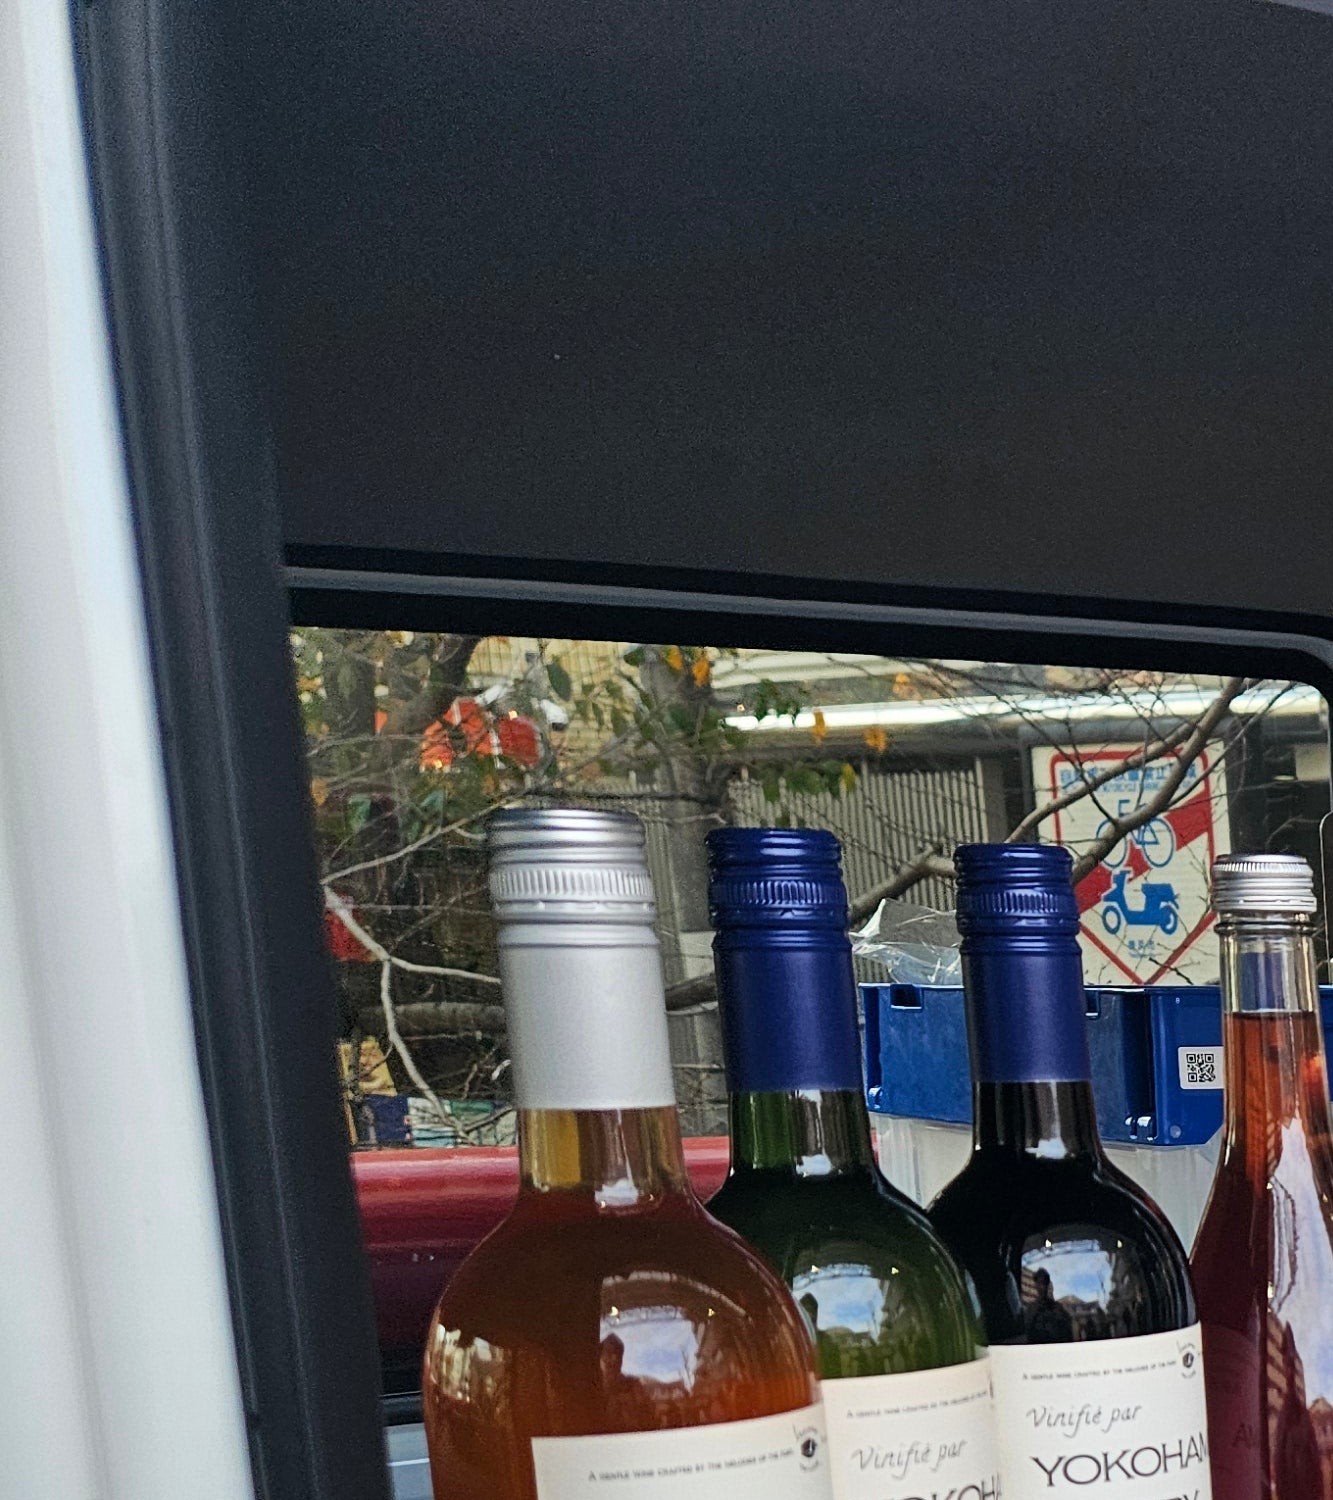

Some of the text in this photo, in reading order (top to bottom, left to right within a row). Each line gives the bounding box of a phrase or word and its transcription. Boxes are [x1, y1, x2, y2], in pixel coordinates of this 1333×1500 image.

[1101, 1402, 1143, 1433] par
[928, 1439, 967, 1472] par
[588, 1471, 597, 1482] A
